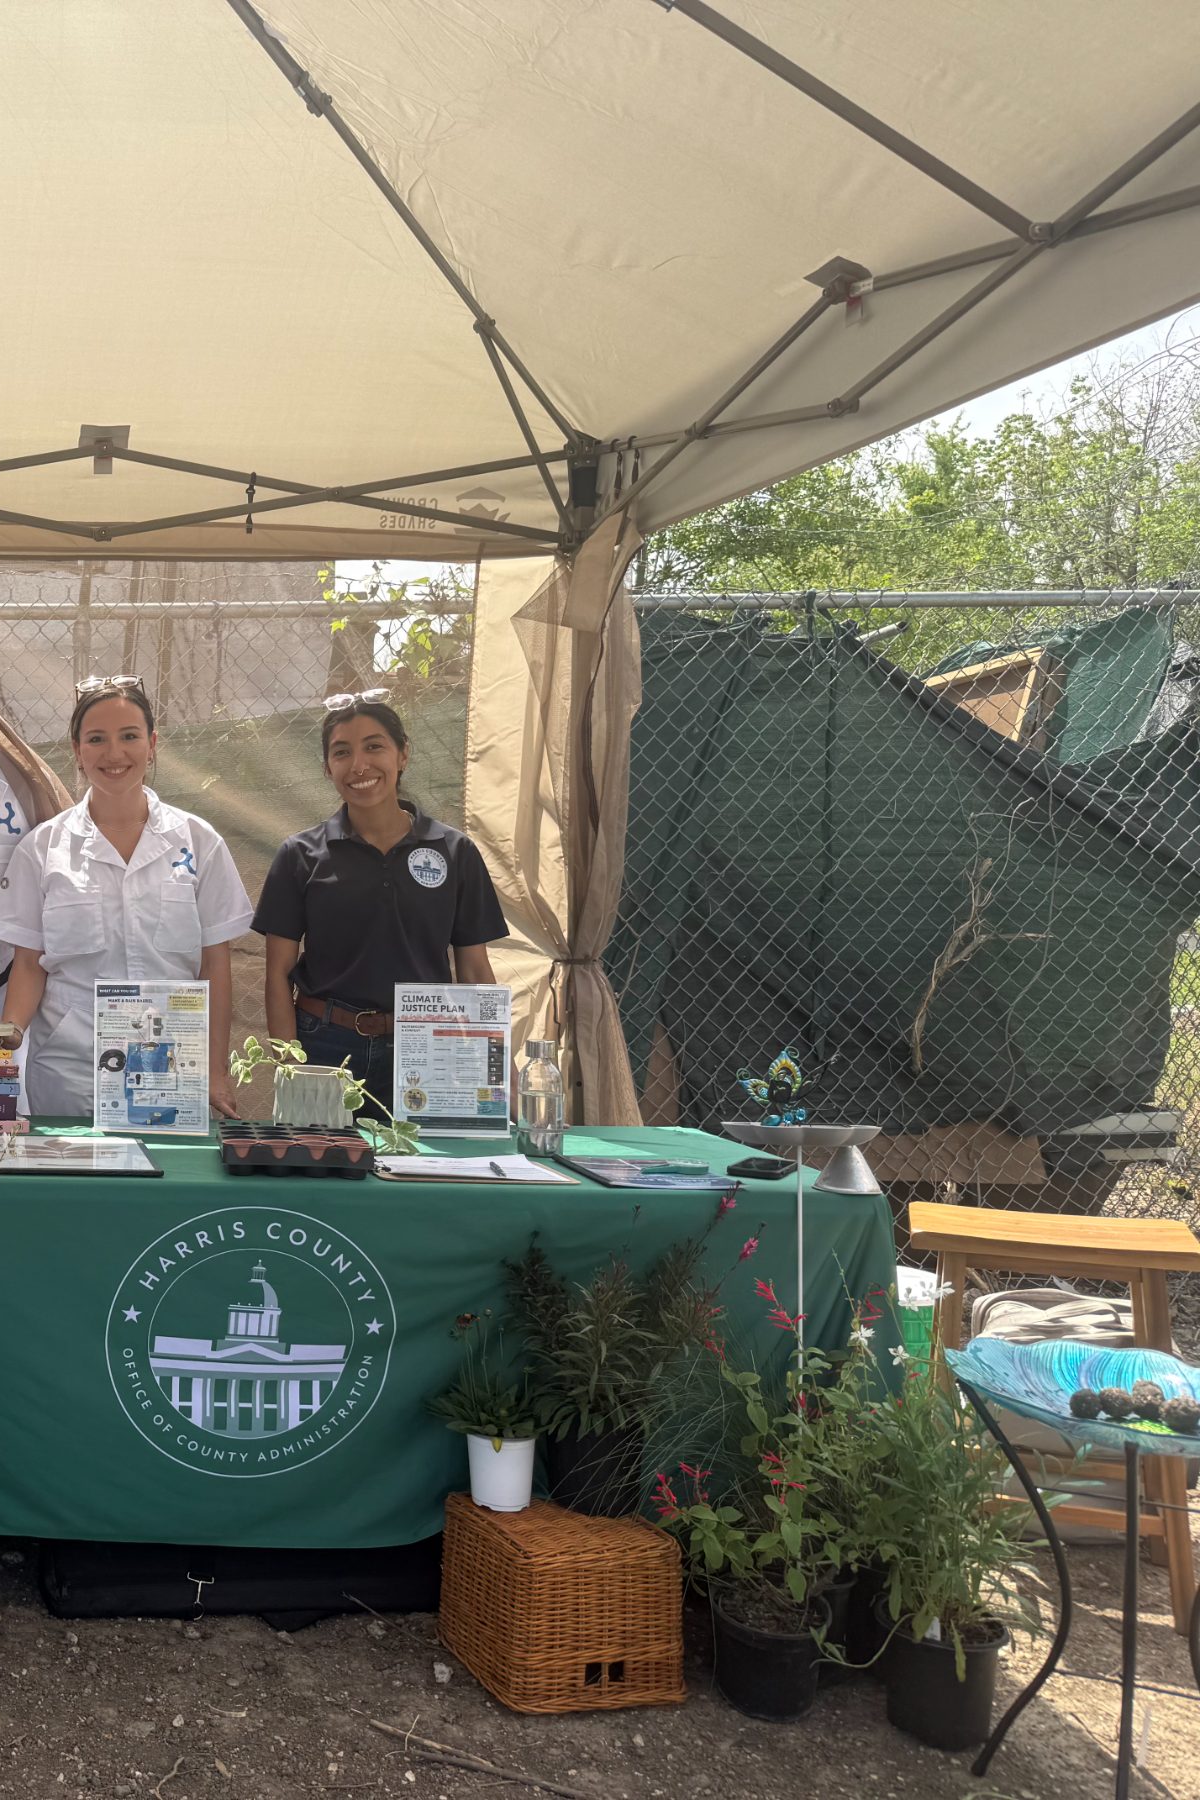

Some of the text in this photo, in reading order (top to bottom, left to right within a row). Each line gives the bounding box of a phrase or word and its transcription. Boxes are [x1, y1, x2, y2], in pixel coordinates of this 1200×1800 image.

[401, 995, 442, 1003] CLIMATE
[401, 1004, 465, 1013] JUSTICE PLAN
[139, 1221, 376, 1302] HARRIS COUNTY
[122, 1347, 374, 1462] OFFICE OF COUNTY ADMINISTRATION
